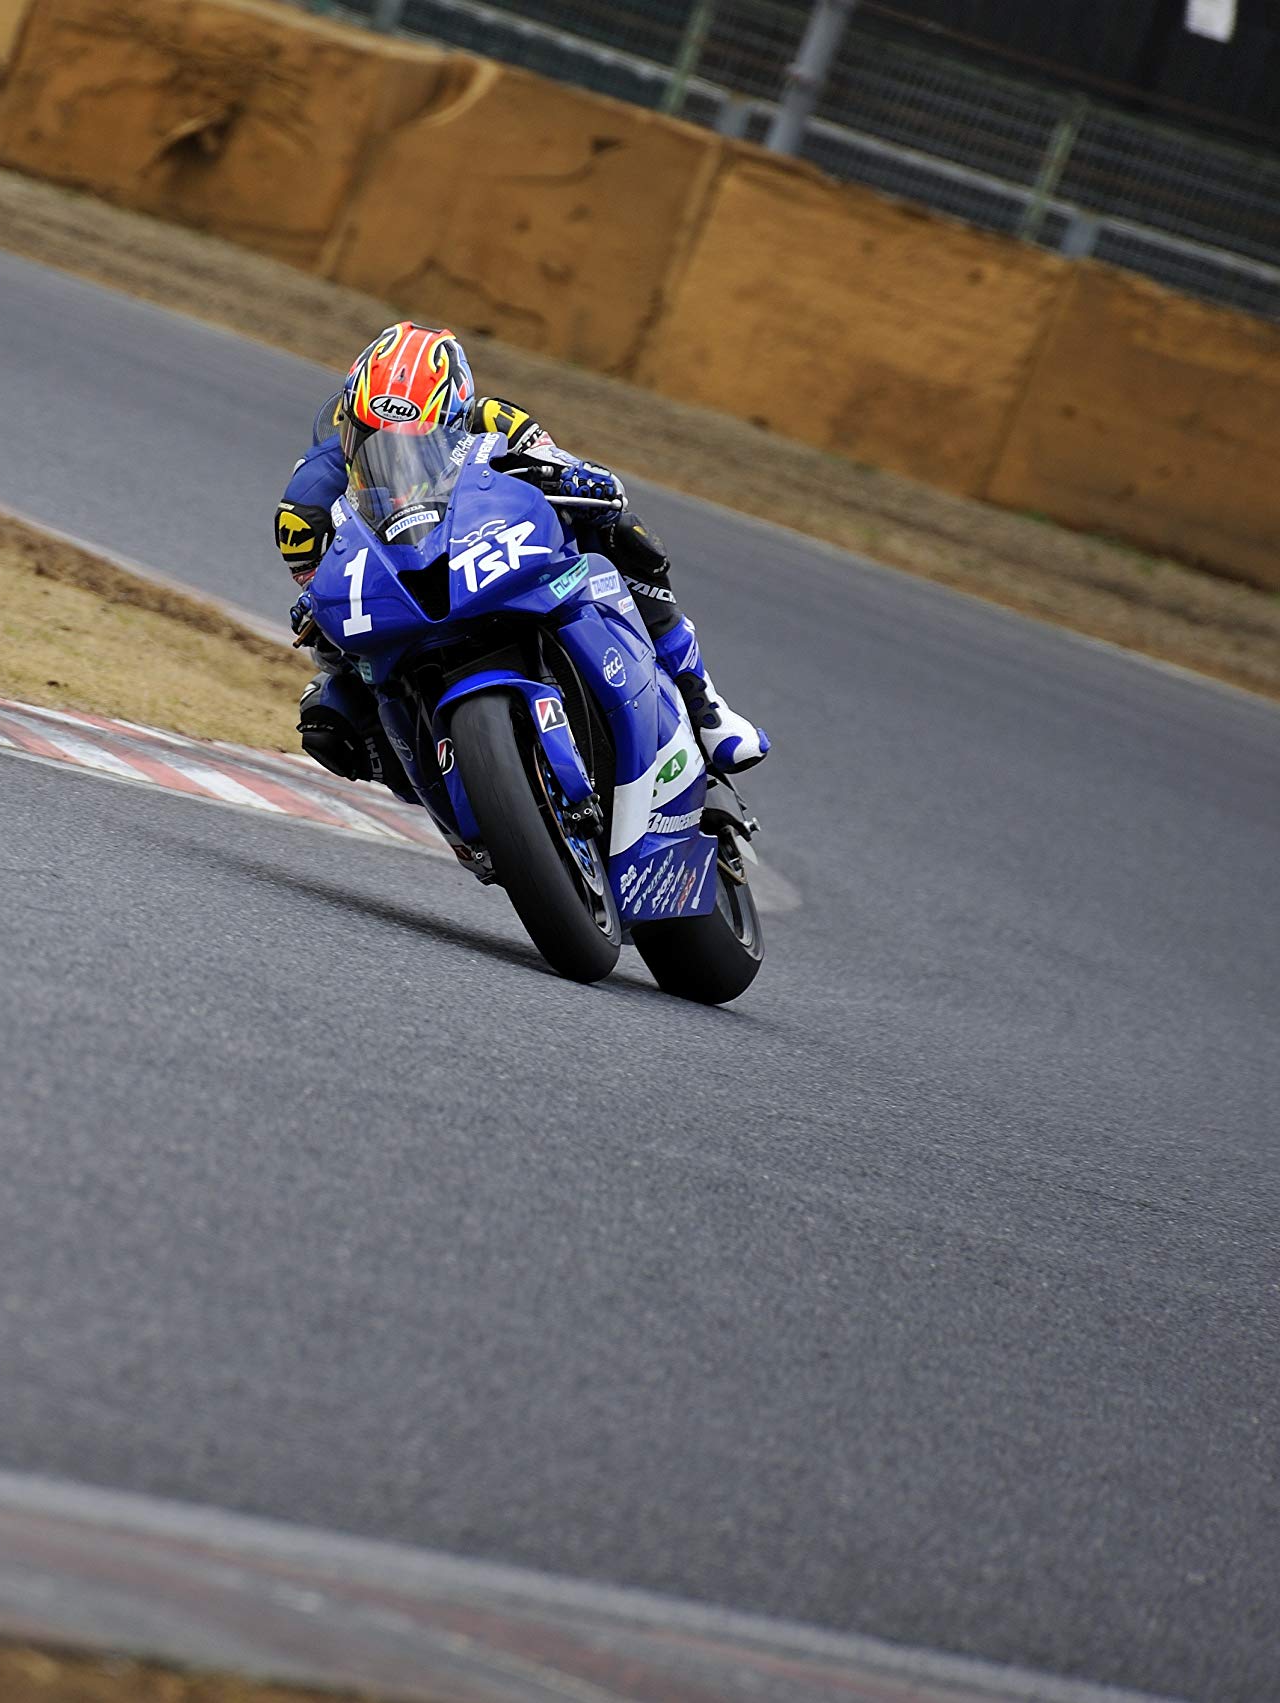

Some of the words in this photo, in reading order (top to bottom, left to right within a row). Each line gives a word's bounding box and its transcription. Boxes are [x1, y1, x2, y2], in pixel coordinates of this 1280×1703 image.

[373, 398, 414, 418] Arai
[388, 512, 435, 537] TAMRON
[390, 503, 426, 521] HONDA
[448, 520, 553, 593] TSR
[342, 547, 373, 637] 1
